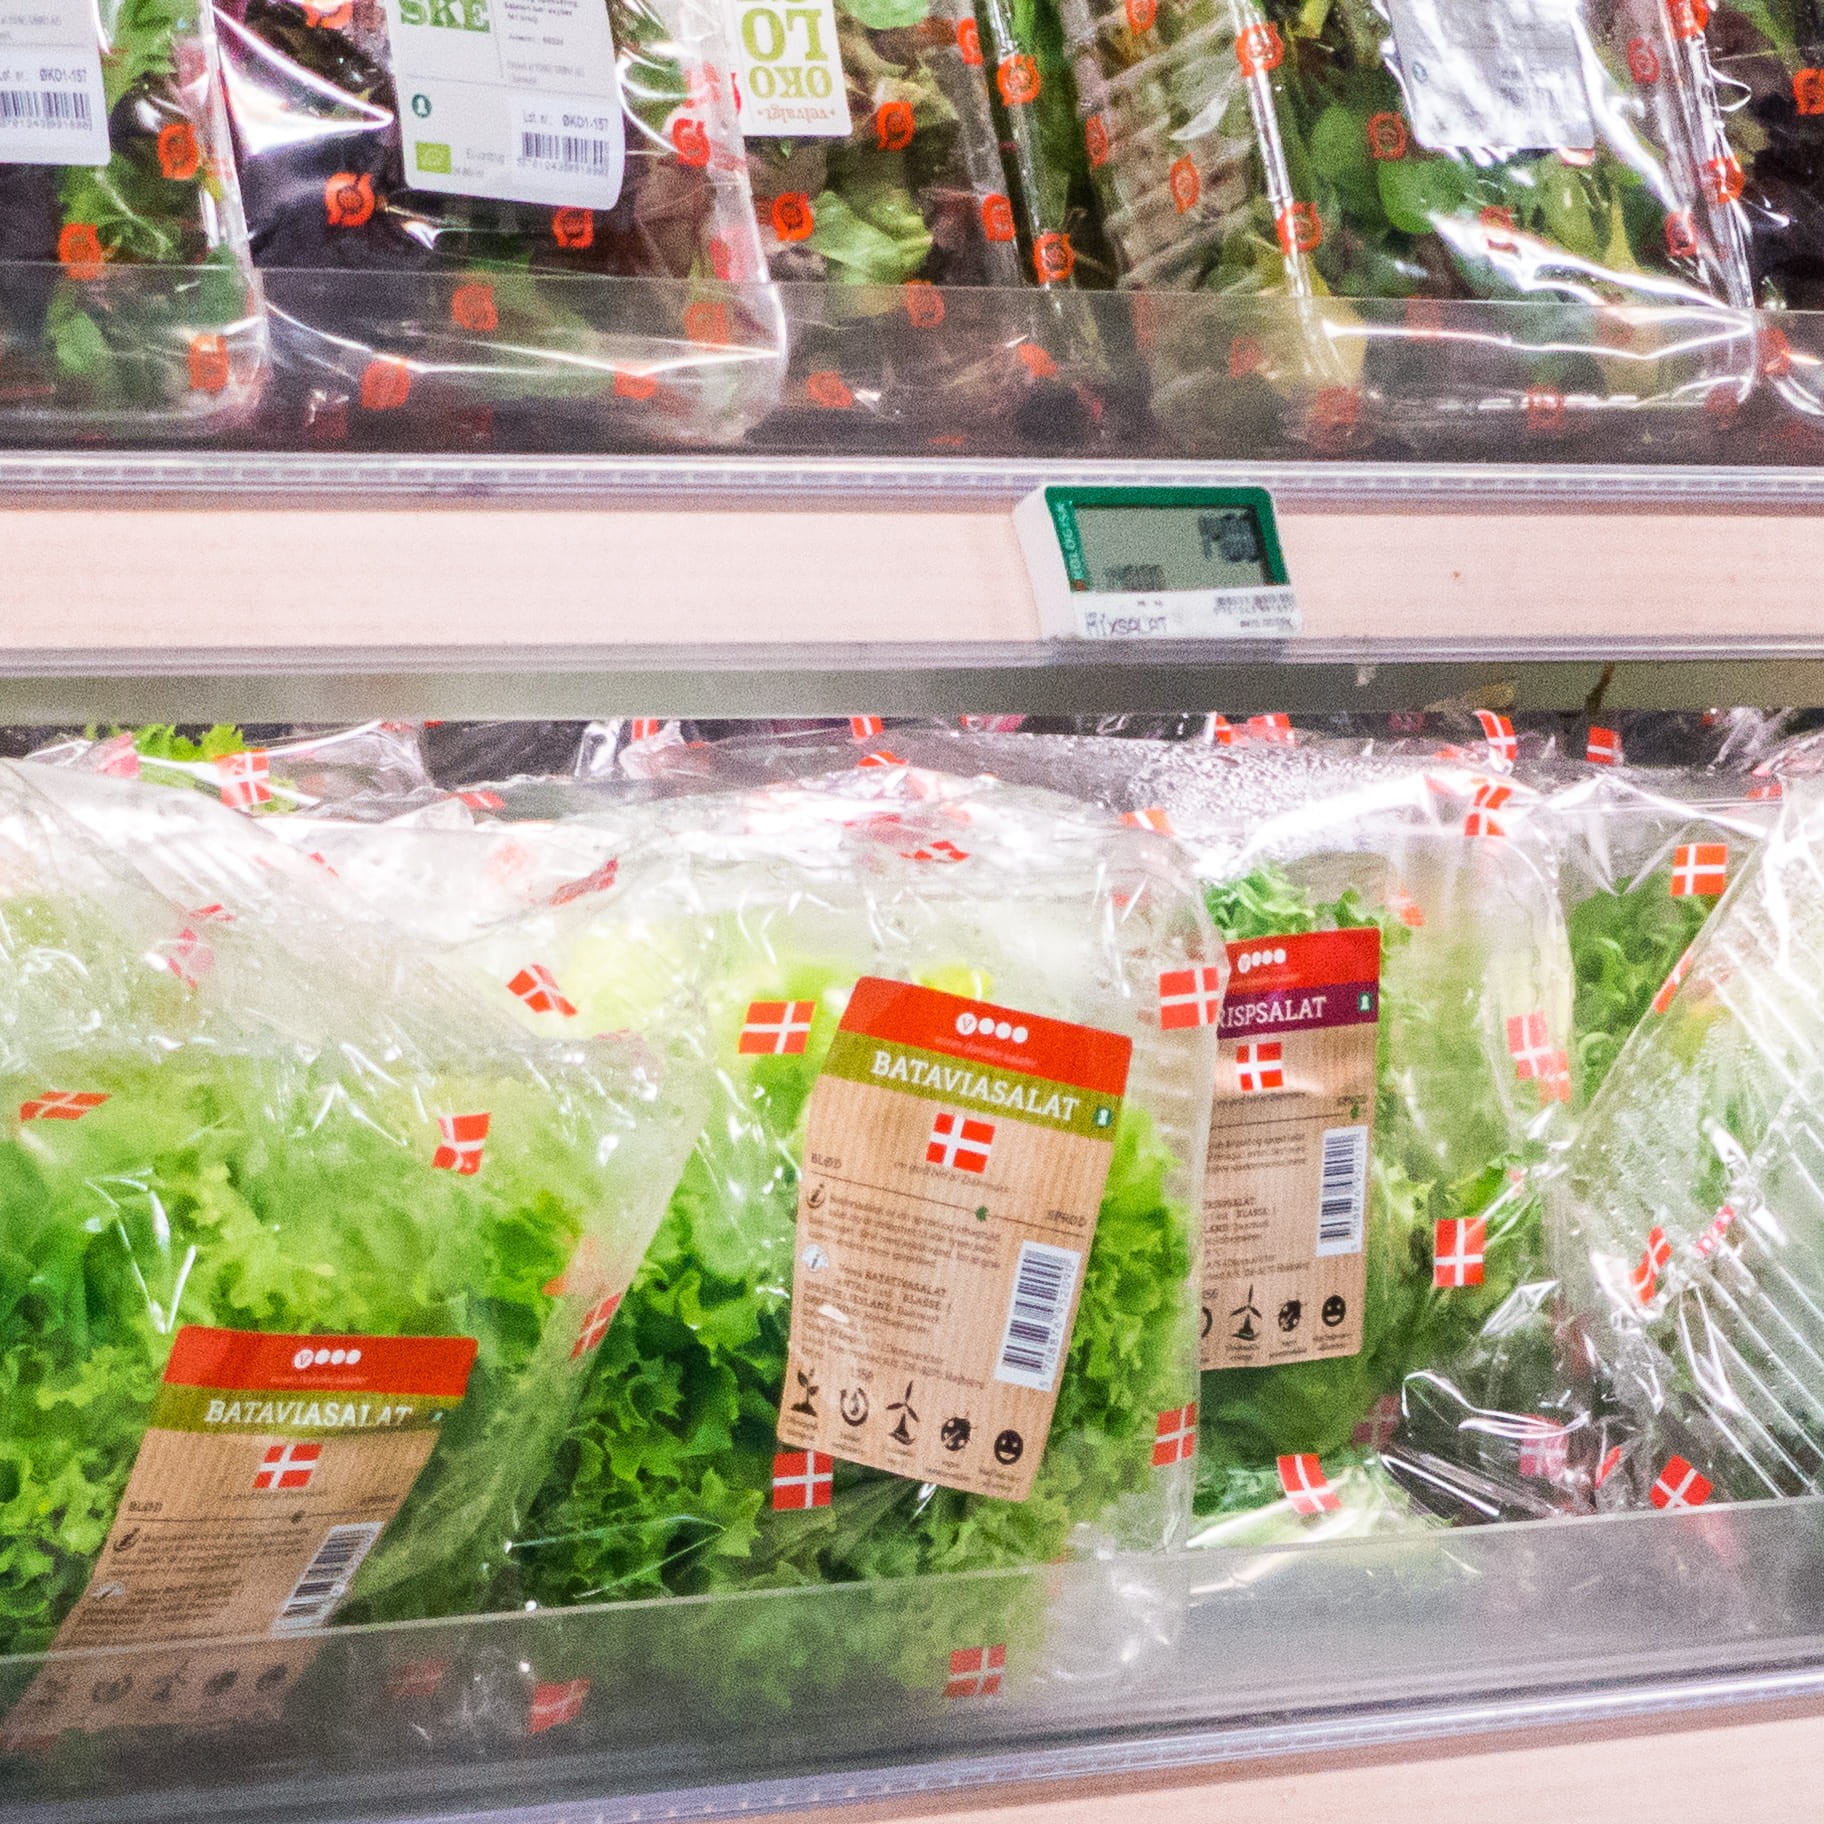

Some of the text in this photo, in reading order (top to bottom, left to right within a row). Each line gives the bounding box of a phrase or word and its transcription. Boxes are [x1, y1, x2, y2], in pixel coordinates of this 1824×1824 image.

[1218, 997, 1327, 1028] RISPSALAT
[871, 1050, 1080, 1121] BATAVIASALAT
[203, 1400, 413, 1427] BATAVIASALAT
